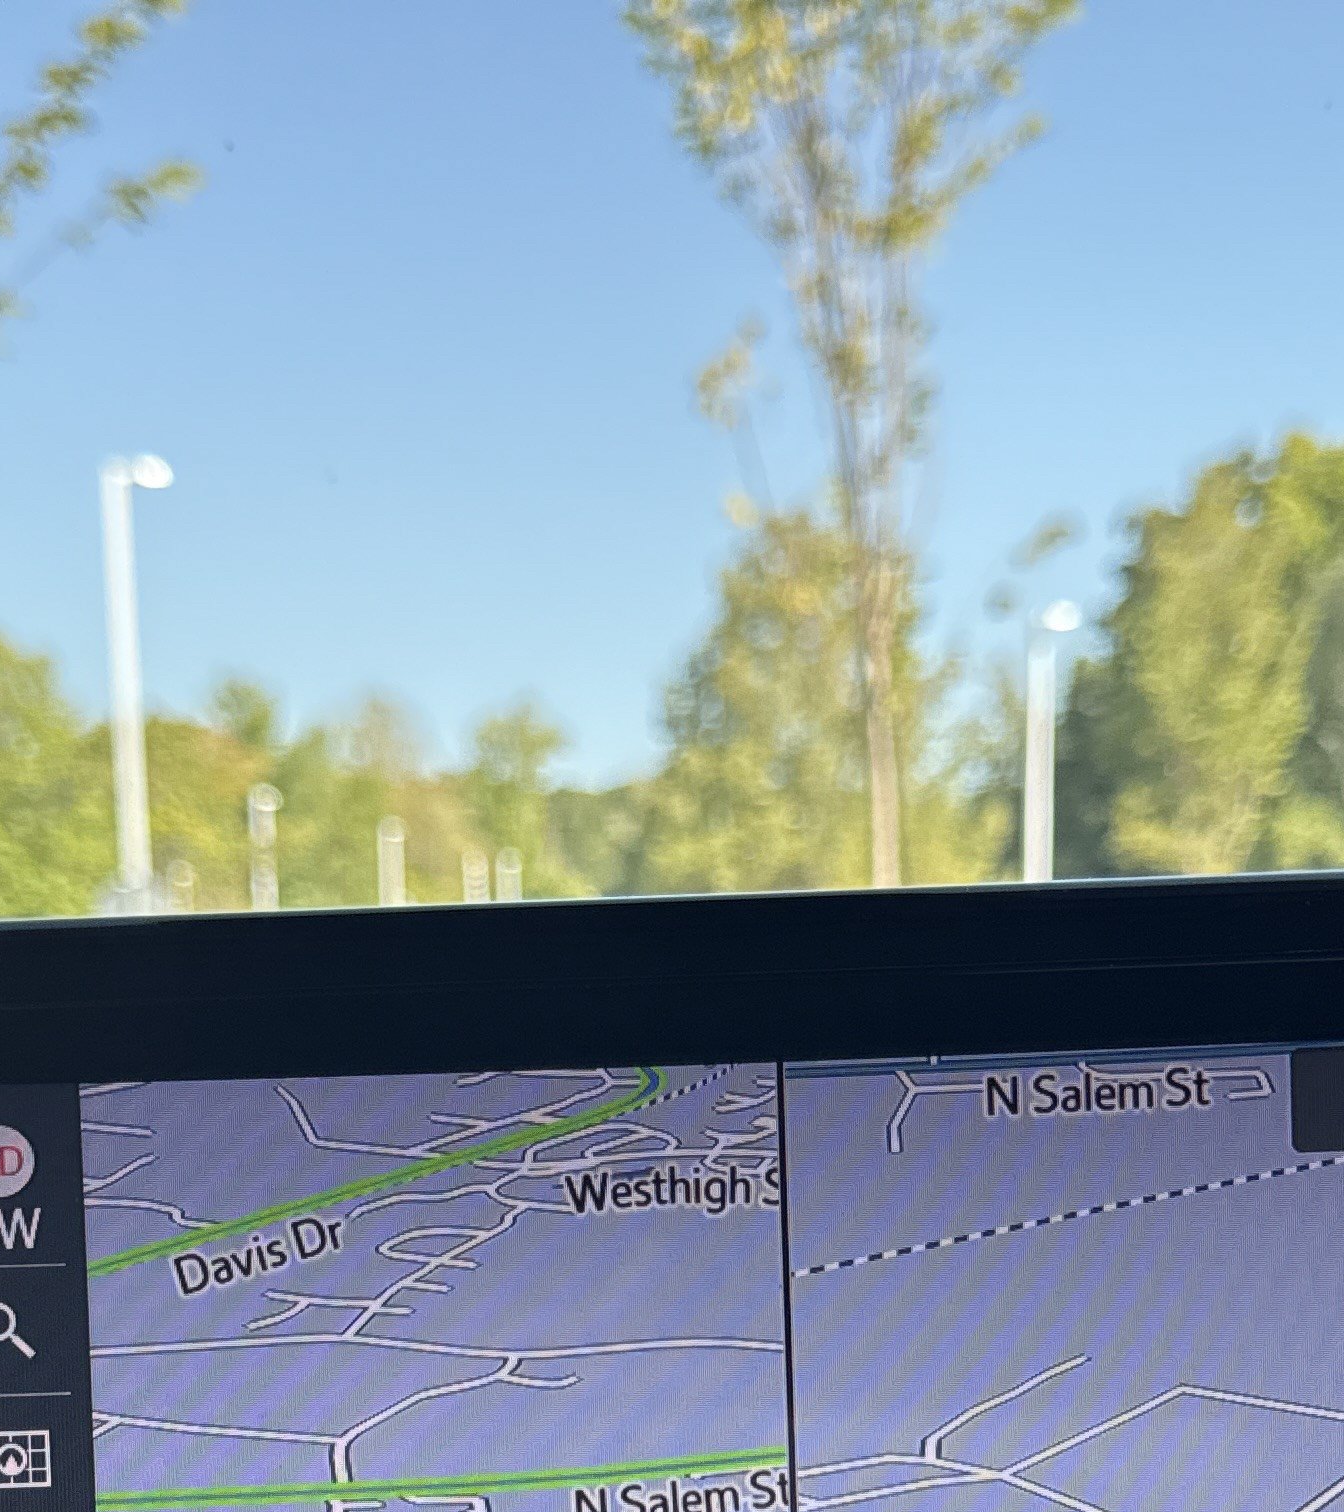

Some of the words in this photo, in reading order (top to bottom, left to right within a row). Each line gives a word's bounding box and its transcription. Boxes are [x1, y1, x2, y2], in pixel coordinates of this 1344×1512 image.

[986, 1075, 1019, 1116] N
[1032, 1069, 1155, 1112] Salem
[1164, 1067, 1212, 1106] St
[565, 1166, 752, 1213] Westhigh
[174, 1234, 286, 1296] Davis
[291, 1216, 343, 1259] Dr
[750, 1470, 789, 1511] St
